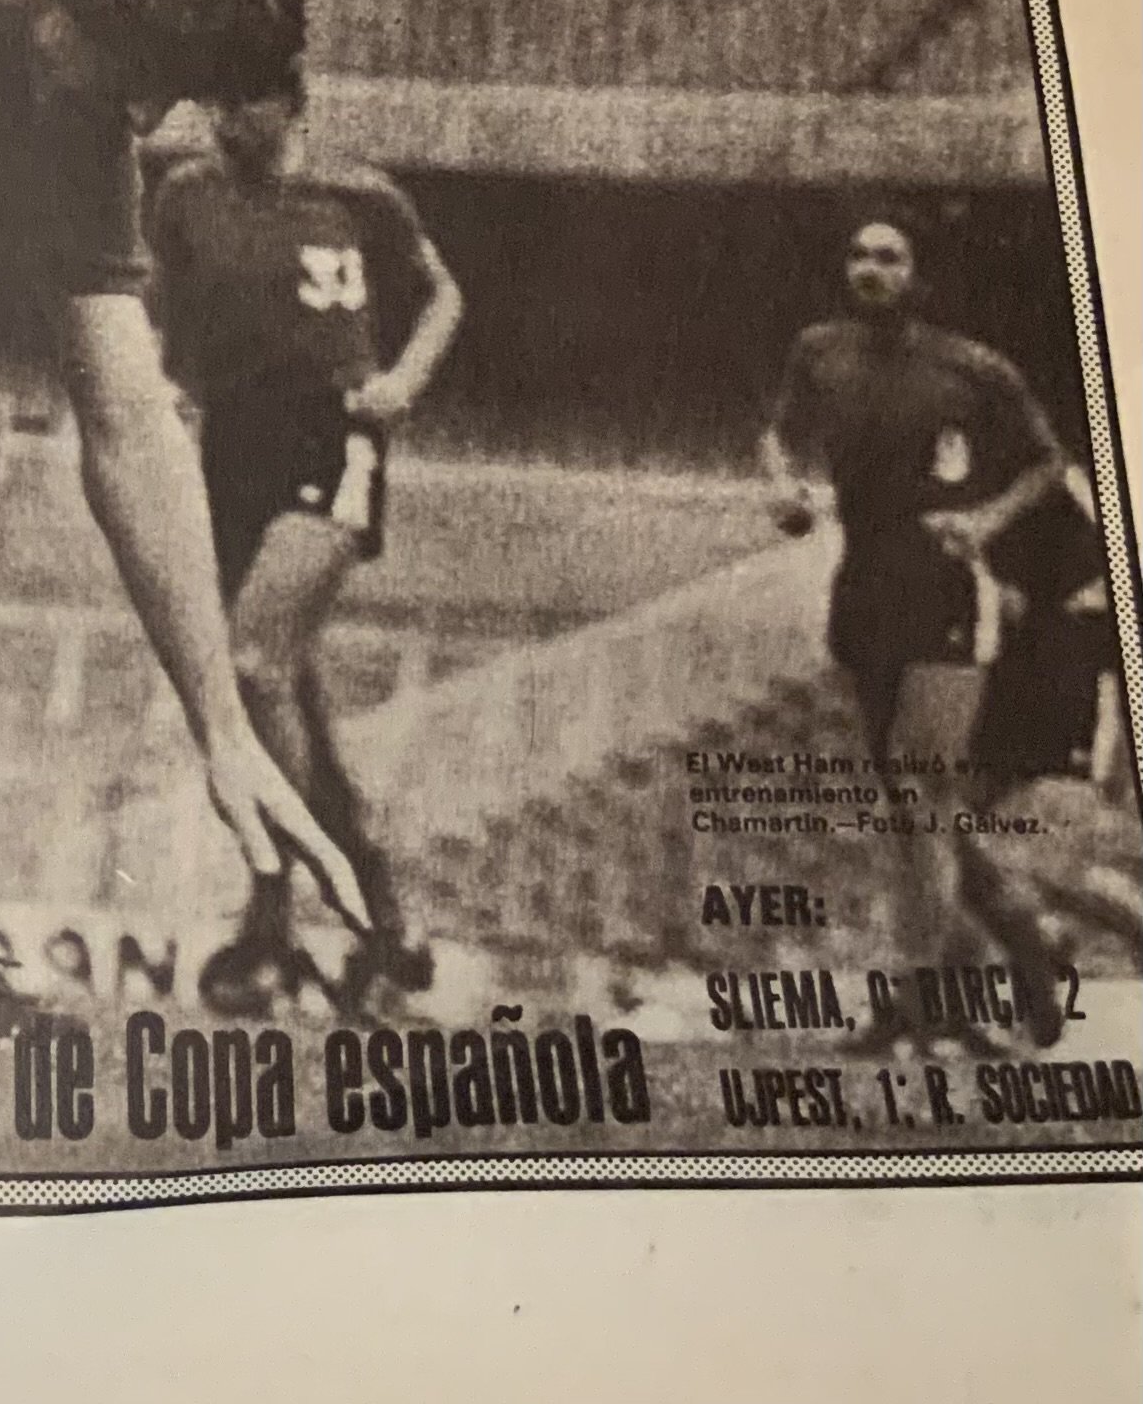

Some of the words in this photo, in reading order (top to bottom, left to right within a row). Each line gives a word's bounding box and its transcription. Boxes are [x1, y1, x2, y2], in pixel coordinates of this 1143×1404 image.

[687, 753, 710, 774] El
[717, 752, 784, 774] West
[793, 753, 854, 774] Ham
[689, 783, 878, 805] entrenamiento
[924, 813, 947, 834] J.
[700, 885, 826, 927] AYER:
[707, 970, 856, 1032] SLIEMA,
[1058, 963, 1086, 1020] 2
[13, 1016, 95, 1137] de
[125, 1011, 296, 1149] Copa
[325, 1004, 651, 1138] española
[718, 1068, 862, 1131] UJPEST,
[924, 1064, 965, 1126] R.
[976, 1059, 1143, 1125] SOCIEDAD
